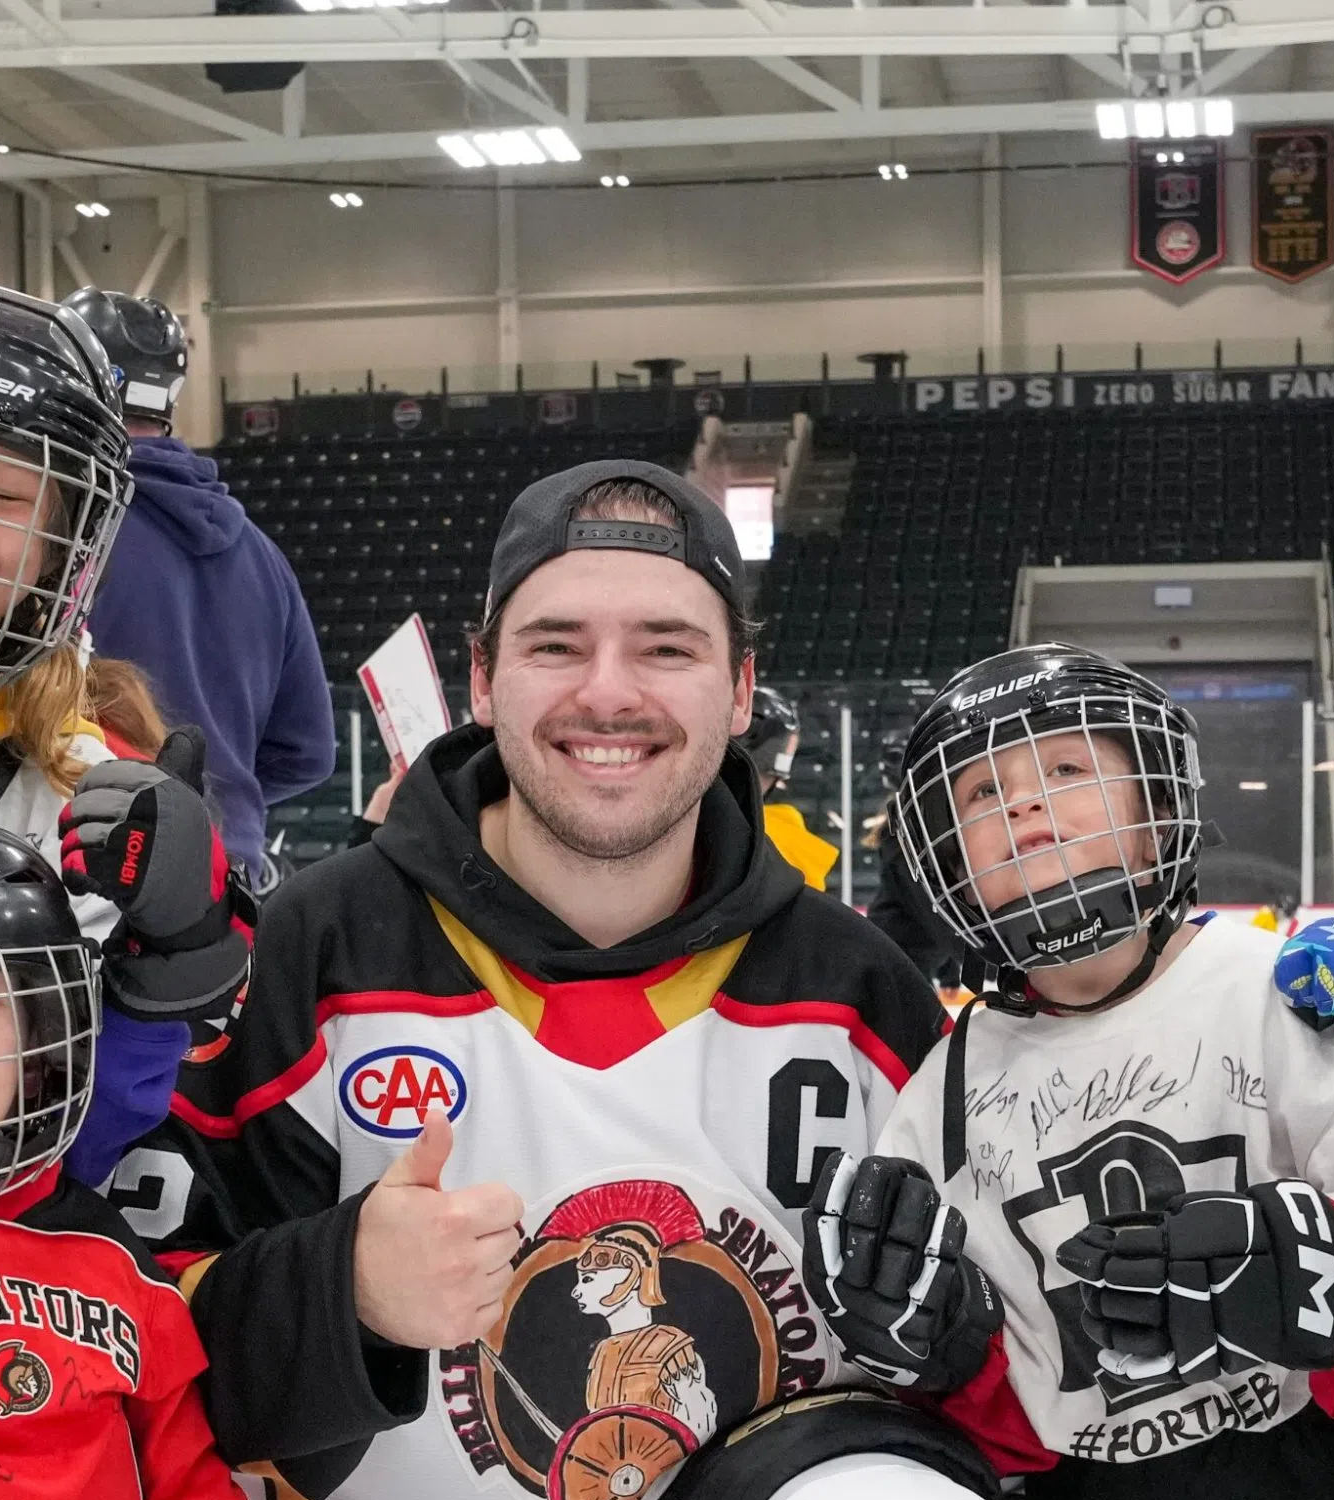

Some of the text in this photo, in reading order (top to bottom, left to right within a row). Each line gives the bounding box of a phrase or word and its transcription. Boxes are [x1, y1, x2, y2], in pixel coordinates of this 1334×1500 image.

[916, 378, 1075, 411] PEPSI
[1094, 383, 1155, 406] ZERO
[1173, 380, 1252, 403] SUGAR
[119, 830, 145, 887] KOMBI
[353, 1057, 453, 1126] CAA
[767, 1058, 850, 1209] C
[707, 1206, 827, 1399] SENATOR
